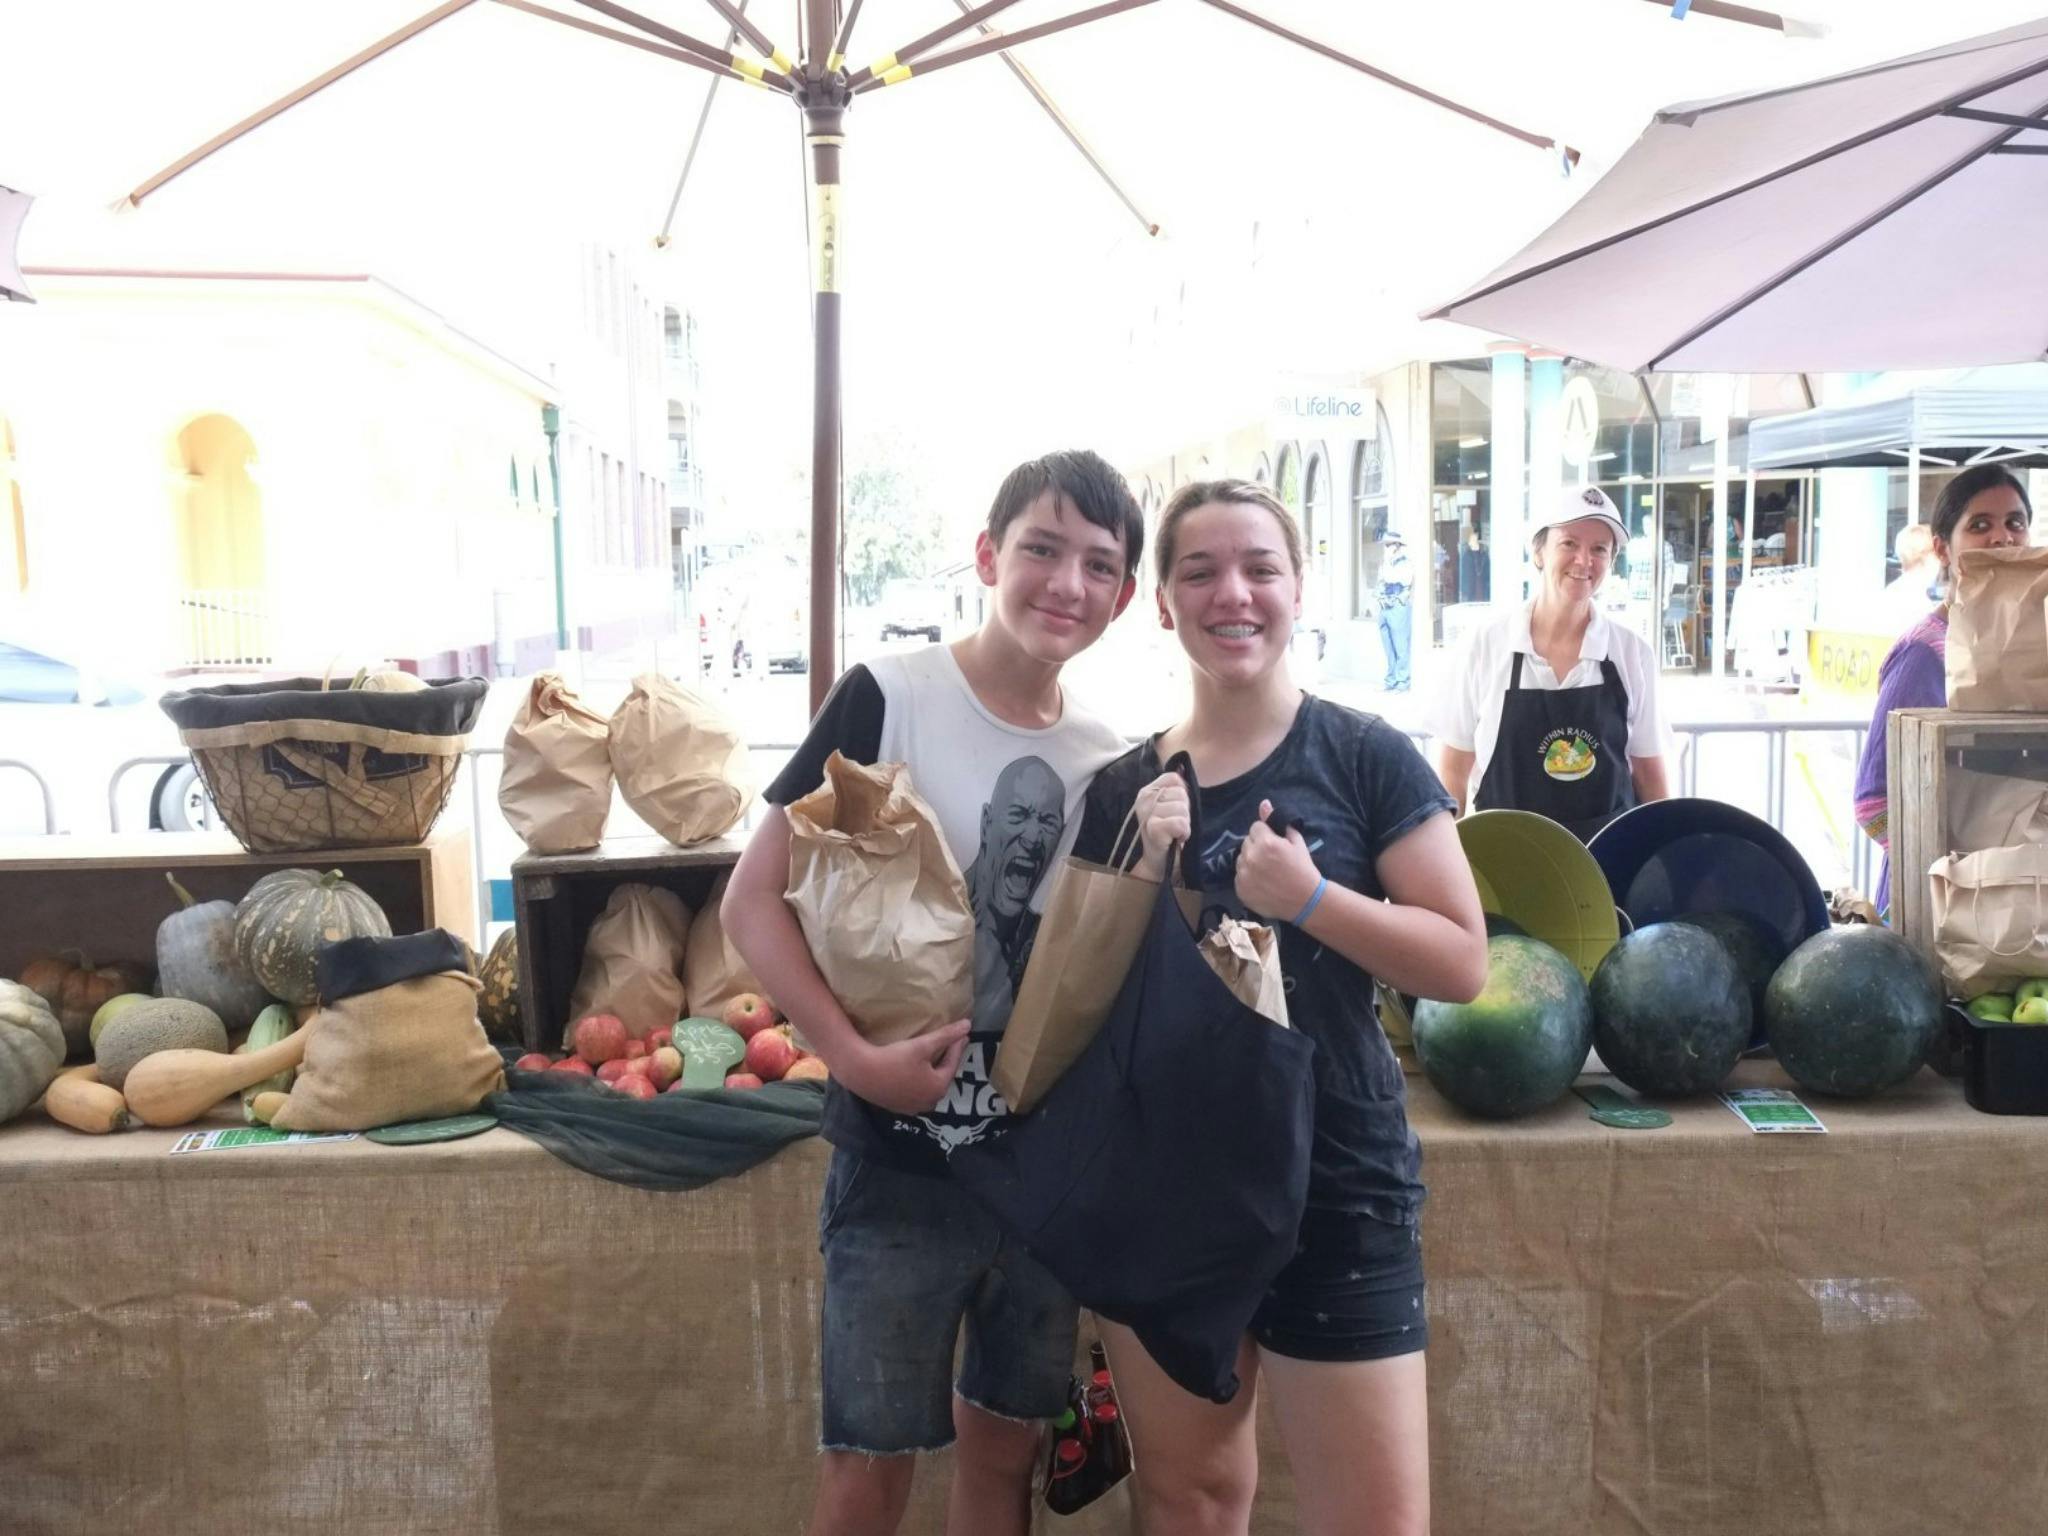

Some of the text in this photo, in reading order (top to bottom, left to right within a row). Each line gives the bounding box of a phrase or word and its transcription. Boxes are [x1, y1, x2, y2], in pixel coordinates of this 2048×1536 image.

[1295, 396, 1362, 416] Lifeline
[1822, 645, 1871, 687] ROAD
[1537, 727, 1600, 754] WITHIN RADIUS
